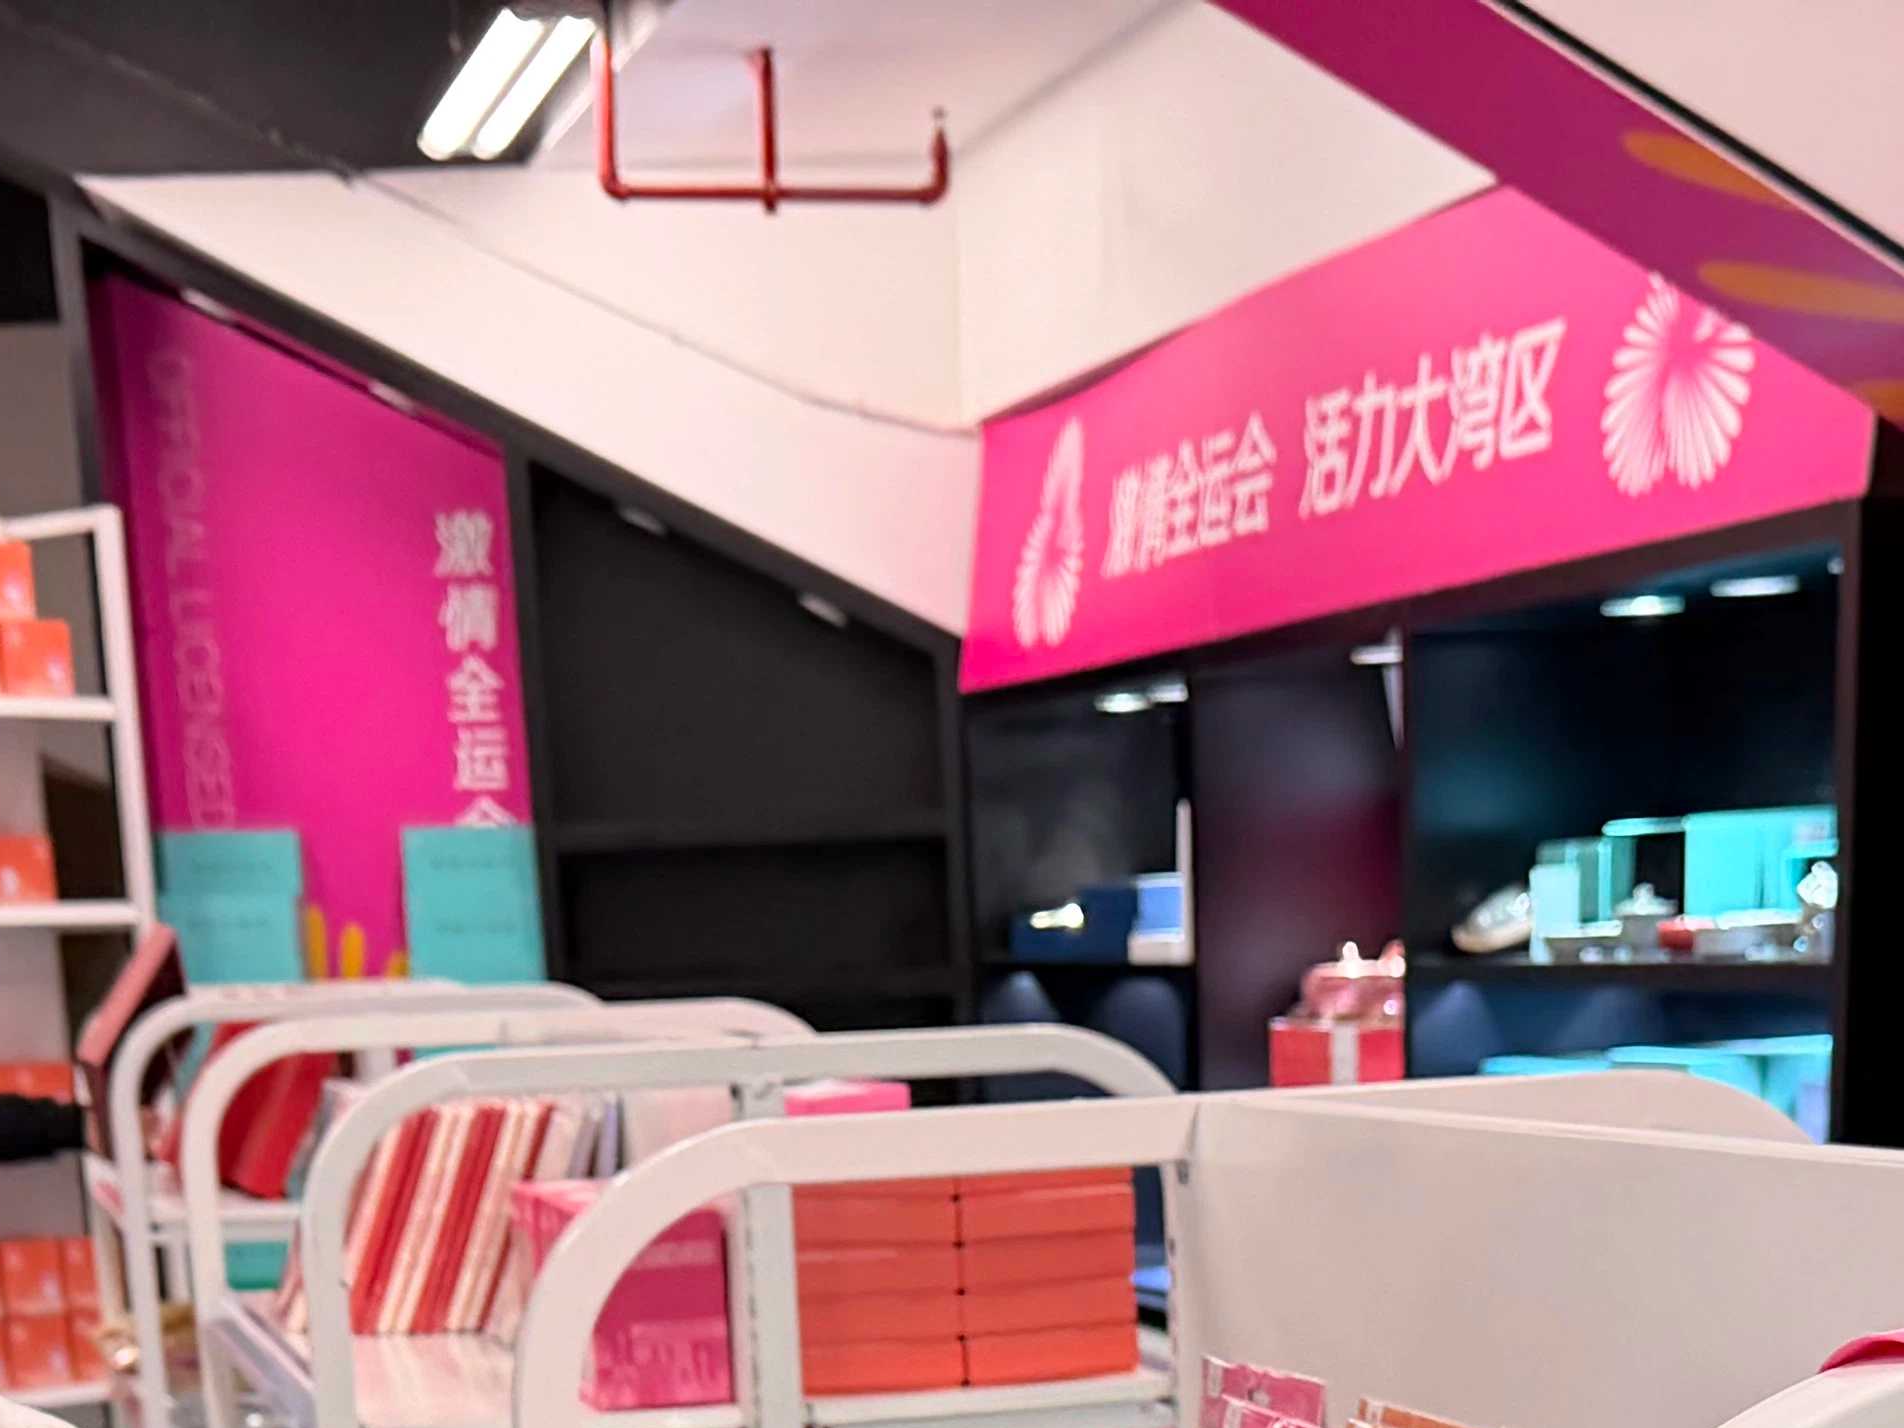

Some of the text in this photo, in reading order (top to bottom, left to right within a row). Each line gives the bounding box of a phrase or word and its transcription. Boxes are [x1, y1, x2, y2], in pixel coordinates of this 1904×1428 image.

[1100, 316, 1566, 579] 激情全运会 活力大湾区
